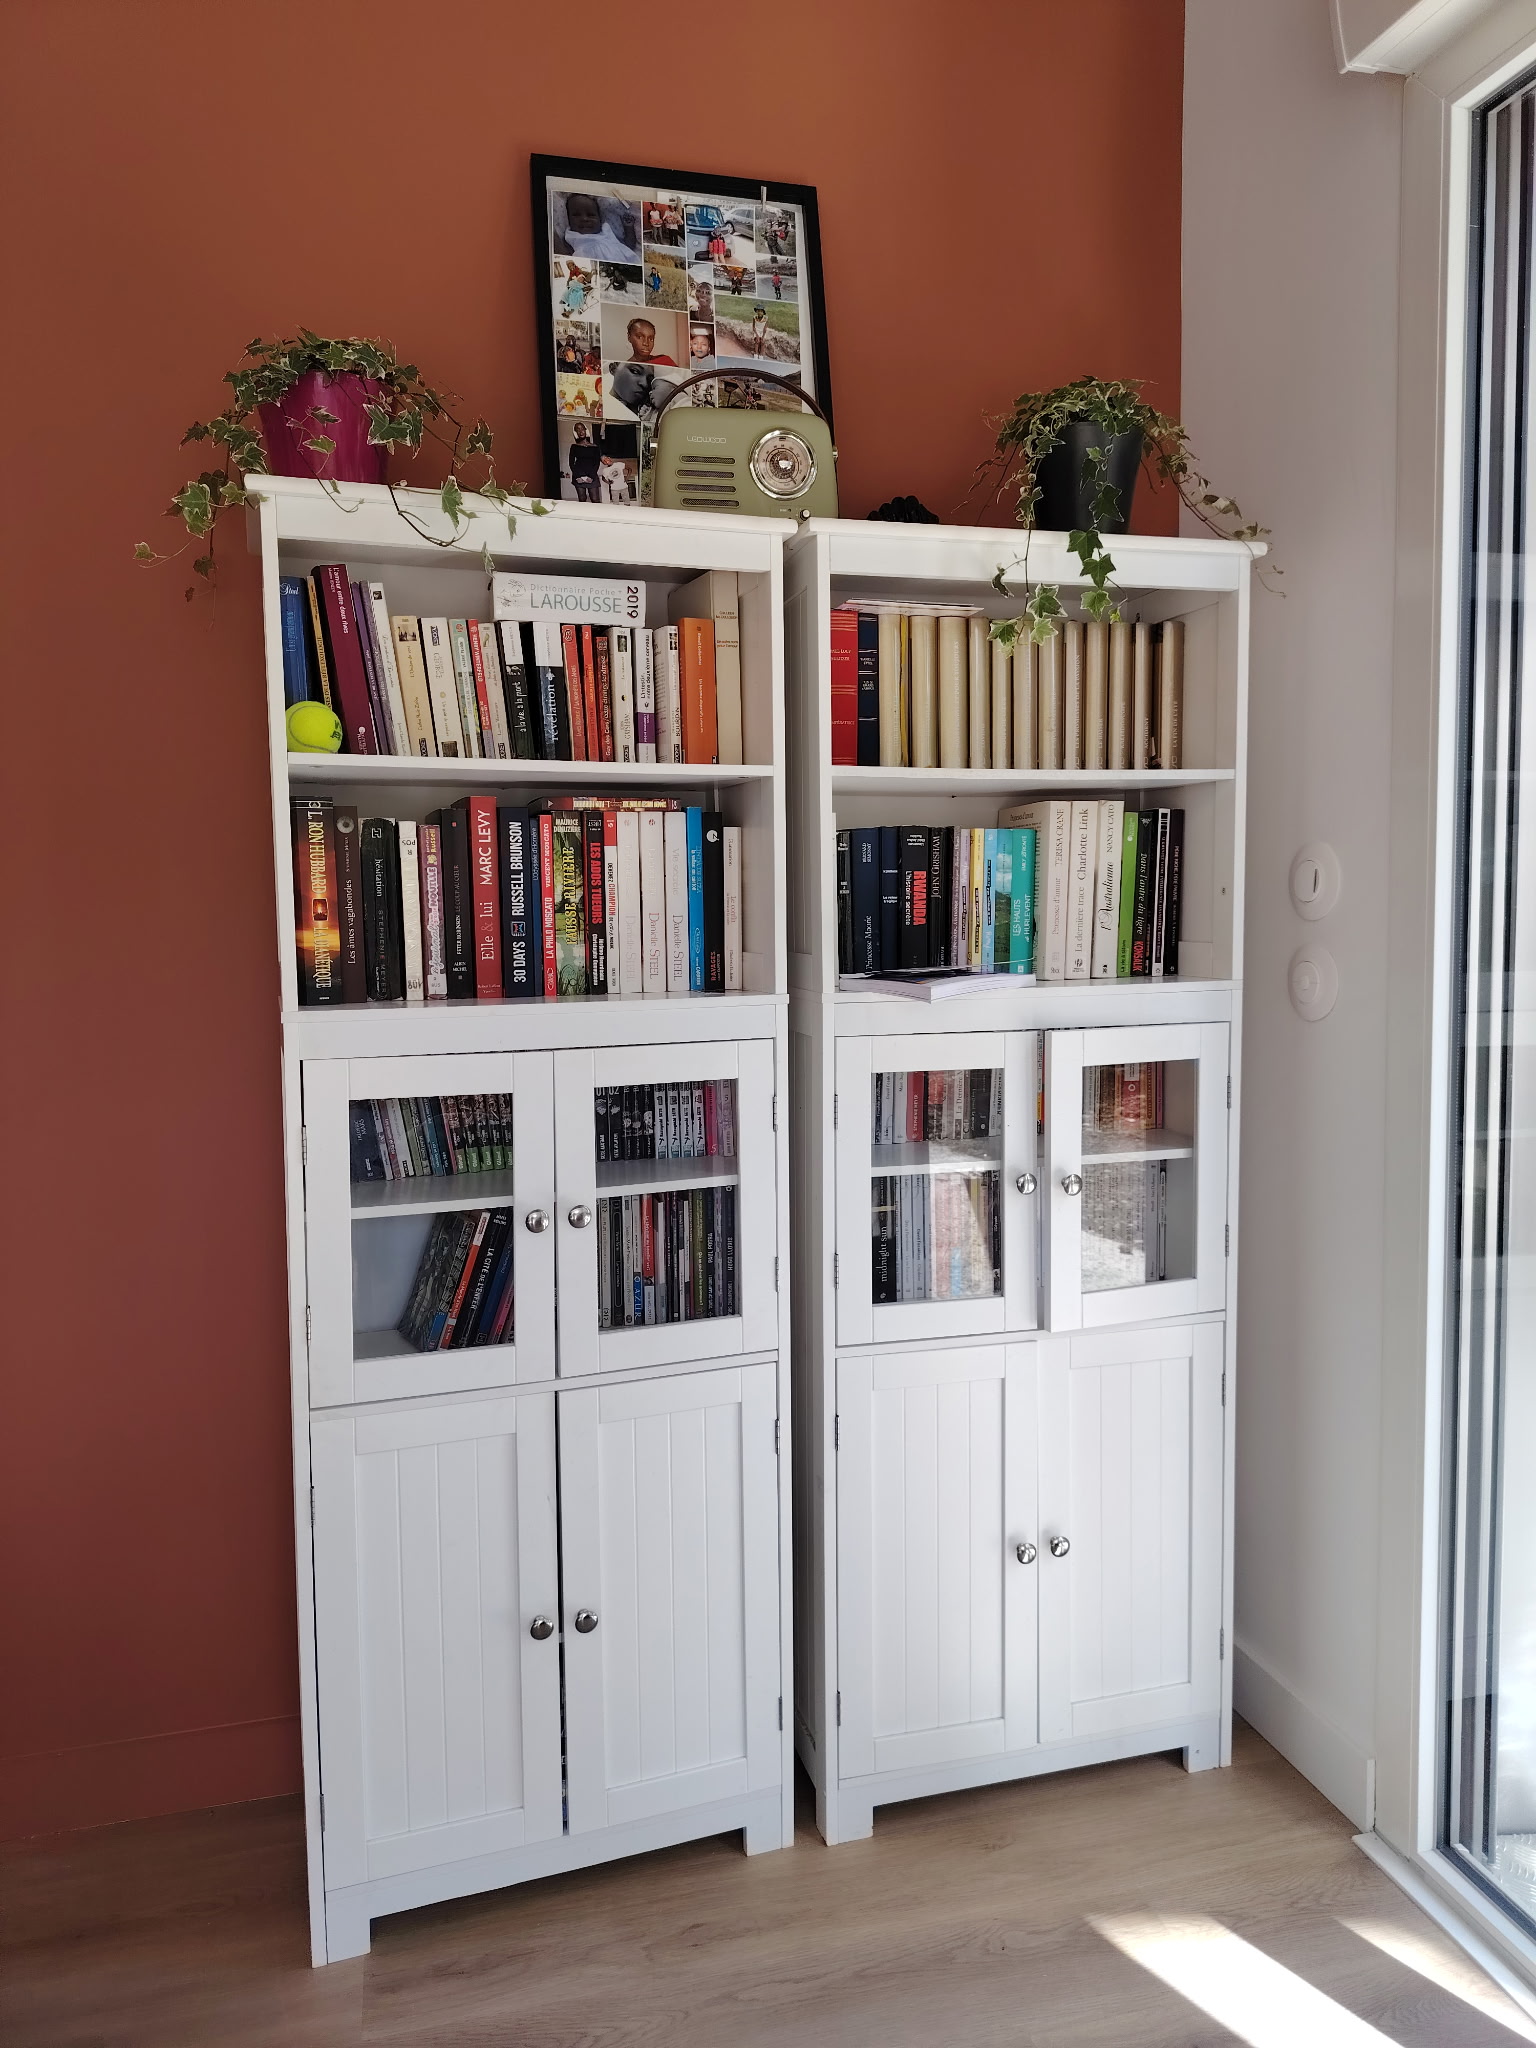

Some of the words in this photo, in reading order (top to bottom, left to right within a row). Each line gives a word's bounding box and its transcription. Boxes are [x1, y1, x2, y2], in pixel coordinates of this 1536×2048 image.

[333, 568, 343, 589] L'amour
[530, 584, 586, 594] Dictionnaire
[590, 587, 615, 596] Poche
[337, 590, 345, 605] entre
[530, 592, 622, 613] LAROUSSE
[626, 586, 639, 619] 2019
[340, 606, 348, 620] deux
[546, 684, 559, 741] révélation
[308, 811, 323, 820] L.
[477, 810, 491, 843] LEVY
[1056, 809, 1064, 837] CRANE
[1078, 809, 1089, 830] Link
[1107, 804, 1115, 825] CATO
[308, 821, 325, 843] RON
[530, 827, 538, 854] d'Homère
[1106, 826, 1114, 853] NANCY
[509, 822, 524, 870] BRUNSON
[590, 842, 601, 858] LES
[931, 836, 941, 874] GRISHAM
[1054, 838, 1064, 867] TERESA
[1076, 834, 1088, 881] Charlotte
[309, 844, 327, 894] HUBBARD
[479, 847, 492, 885] MARC
[561, 847, 576, 900] RIVIÈRE
[590, 860, 602, 886] ADOS
[1139, 853, 1148, 873] Dans
[374, 859, 385, 897] hésitation
[428, 867, 438, 907] NOUILLE
[673, 864, 681, 896] secrète
[930, 876, 941, 899] JOHN
[1052, 878, 1061, 904] d'amour
[1138, 874, 1149, 902] l'antre
[344, 880, 356, 926] vagabondes
[511, 872, 525, 916] RUSSELL
[591, 888, 603, 924] TUEURS
[913, 871, 927, 926] RWANDA
[1077, 887, 1085, 906] trace
[479, 902, 493, 918] lui
[544, 897, 553, 928] MOSCATO
[729, 905, 737, 924] conflit
[1013, 899, 1021, 923] HAUTS
[1052, 906, 1061, 935] Promesses
[1137, 903, 1146, 913] du
[314, 927, 327, 937] LA
[481, 922, 494, 932] &
[565, 903, 578, 945] FAUSSE
[649, 912, 660, 947] Danielle
[672, 915, 683, 949] Danielle
[1012, 924, 1021, 936] LES
[1074, 907, 1084, 942] dernière
[1135, 914, 1145, 935] tigre
[347, 928, 356, 949] âmes
[481, 936, 494, 961] Elle
[545, 929, 554, 948] PHILO
[1075, 943, 1083, 952] La
[313, 940, 334, 989] DIANÉTIQUE
[347, 951, 356, 964] Les
[512, 941, 526, 967] DAYS
[546, 950, 554, 959] LA
[649, 948, 661, 980] STEEL
[674, 950, 685, 981] STEEL
[865, 941, 873, 970] Princesse
[1132, 940, 1144, 972] KONSALIK
[514, 970, 526, 983] 30
[956, 1106, 962, 1114] La
[481, 1258, 492, 1273] CITÉ
[486, 1248, 495, 1257] LA
[875, 1243, 890, 1282] midnight
[471, 1284, 484, 1310] L'ENFER
